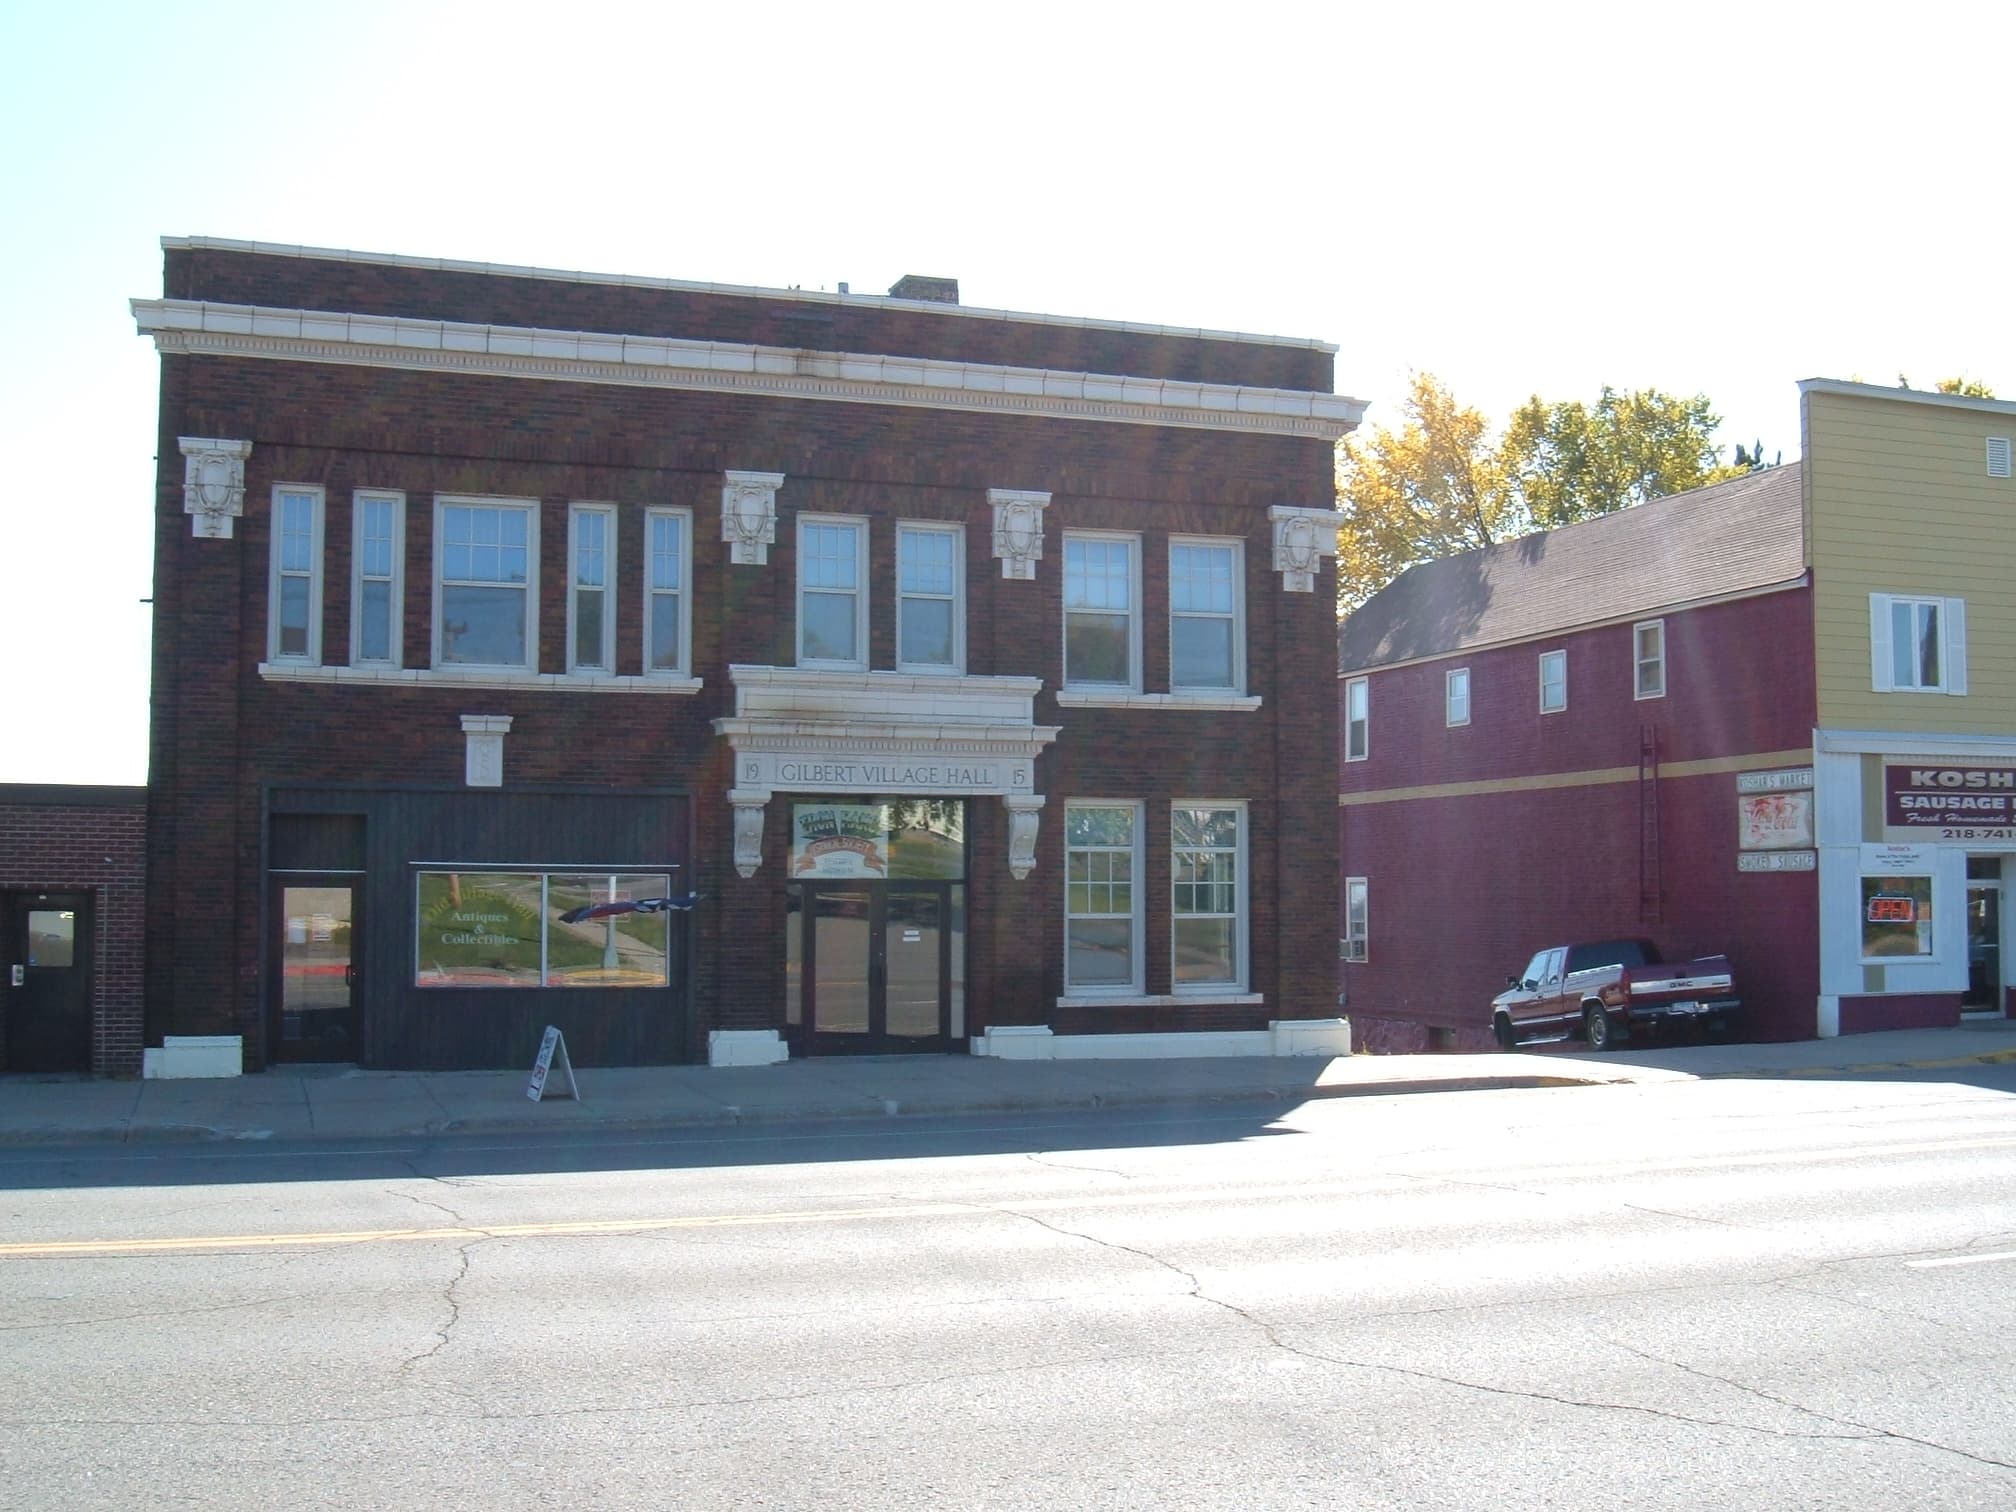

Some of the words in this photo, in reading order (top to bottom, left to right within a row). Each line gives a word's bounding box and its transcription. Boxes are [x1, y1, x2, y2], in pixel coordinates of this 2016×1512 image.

[745, 762, 760, 780] 19
[781, 763, 857, 783] GILBERT
[862, 765, 940, 784] VILLAGE
[946, 767, 993, 785] HALL
[1012, 769, 1025, 785] 15
[1900, 796, 2005, 809] SAUSAGE
[451, 912, 509, 923] Antiques
[474, 924, 485, 935] &
[441, 933, 519, 945] Collectibles
